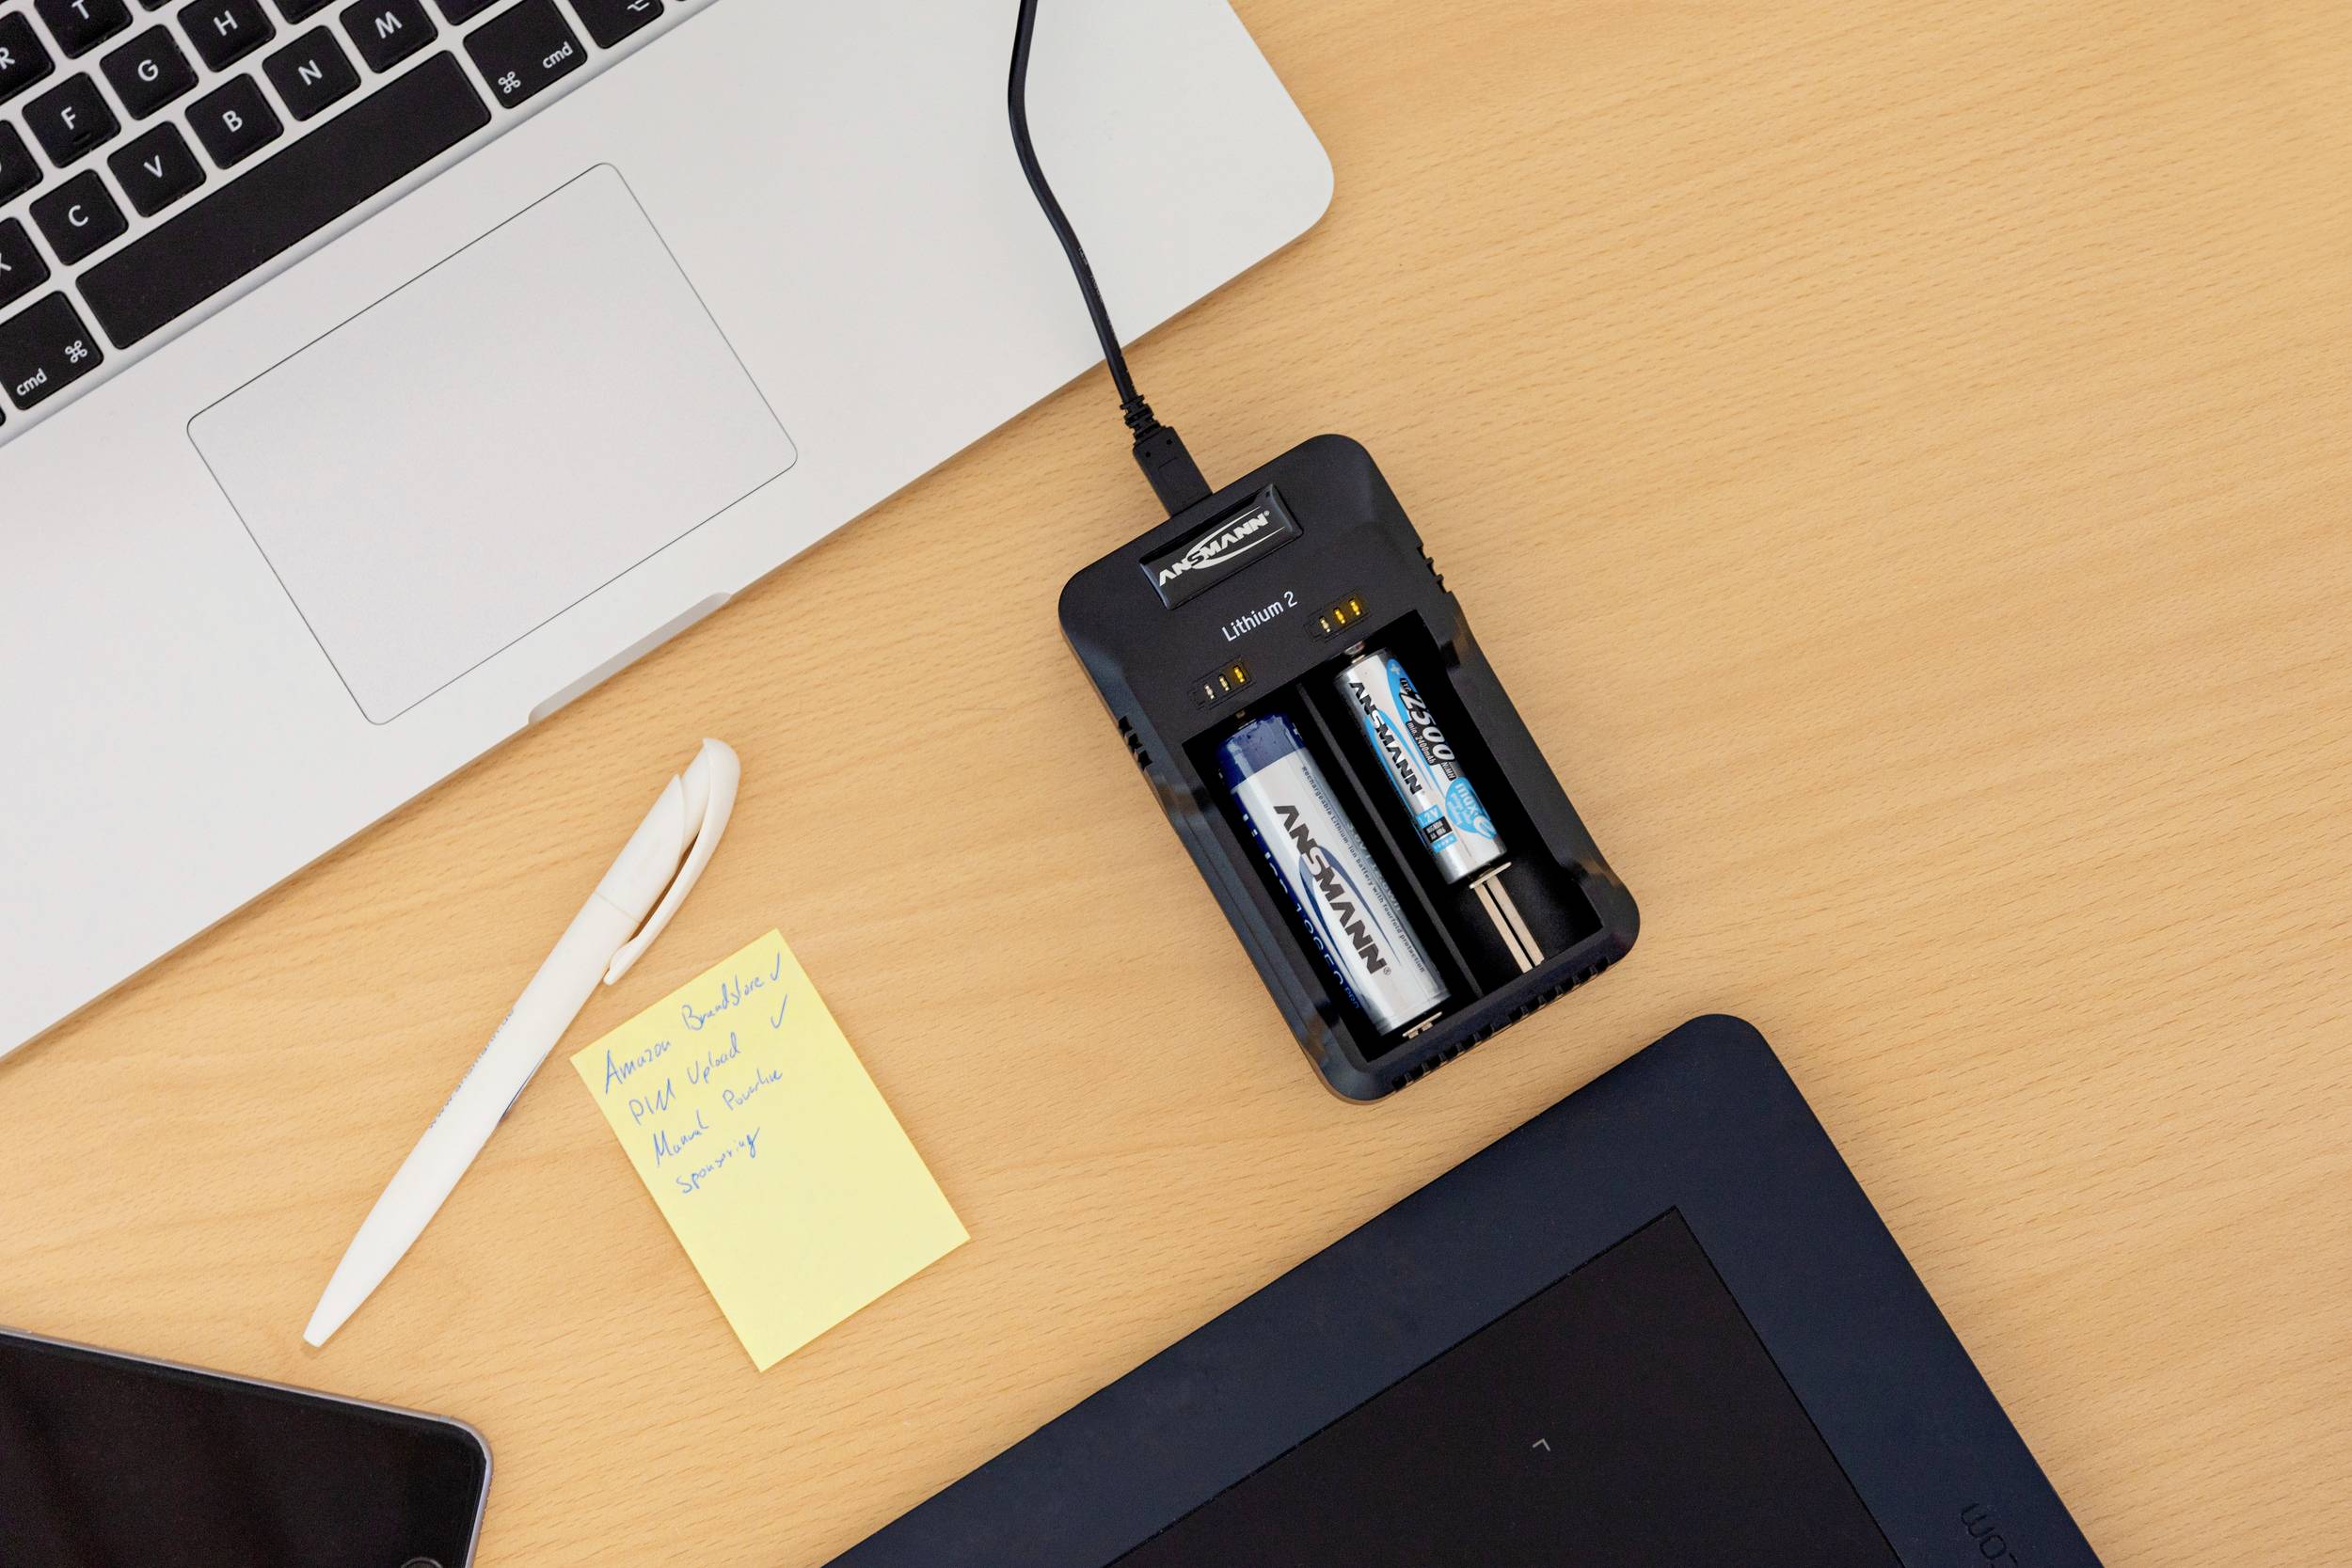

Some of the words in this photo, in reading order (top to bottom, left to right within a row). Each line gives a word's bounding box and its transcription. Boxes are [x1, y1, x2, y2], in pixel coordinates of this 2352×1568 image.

[72, 0, 89, 19] T
[214, 10, 238, 36] H
[374, 10, 403, 39] M
[0, 47, 16, 70] R
[542, 41, 573, 69] cmd
[137, 59, 159, 82] G
[297, 59, 323, 86] N
[60, 106, 76, 130] F
[222, 110, 243, 133] B
[143, 154, 164, 178] V
[68, 204, 89, 227] C
[16, 368, 48, 396] cmd
[1221, 598, 1284, 643] Lithium
[1280, 590, 1298, 609] 2
[1399, 691, 1456, 762] 2500
[603, 1038, 673, 1095] Amazon
[686, 1031, 742, 1085] Upload
[651, 1109, 710, 1166] Manual
